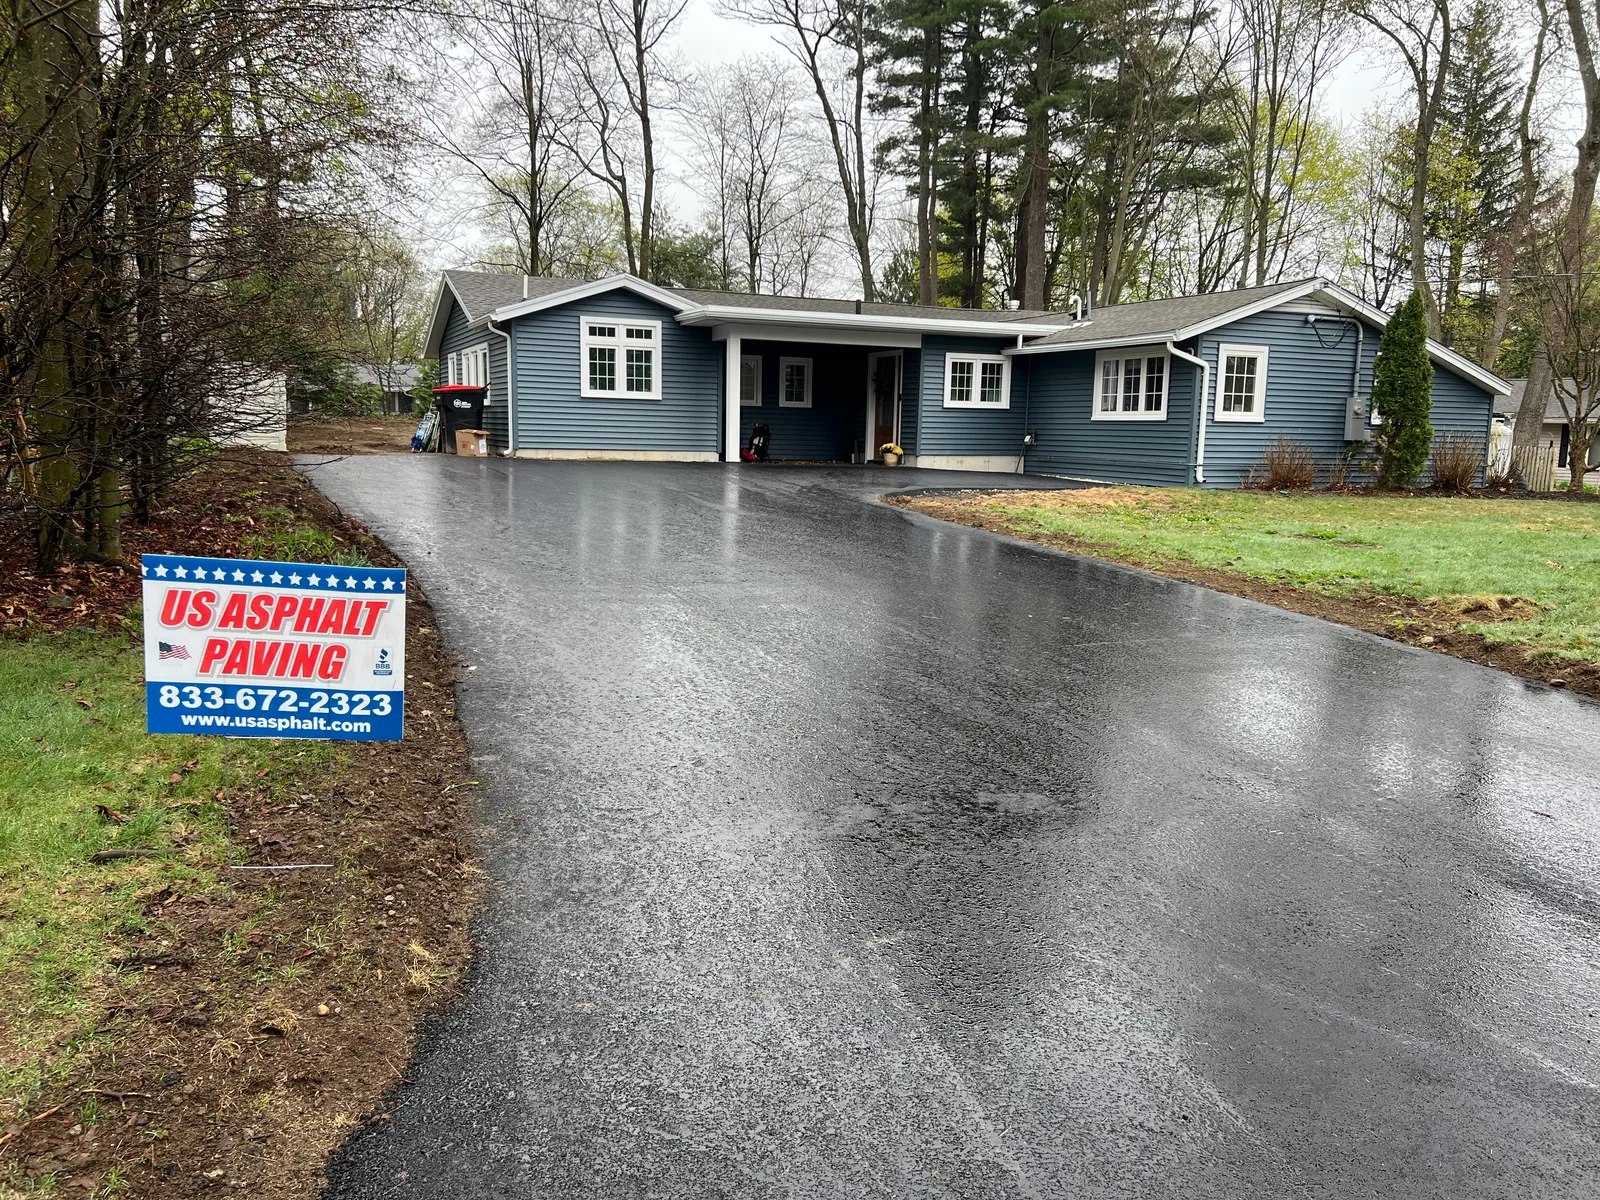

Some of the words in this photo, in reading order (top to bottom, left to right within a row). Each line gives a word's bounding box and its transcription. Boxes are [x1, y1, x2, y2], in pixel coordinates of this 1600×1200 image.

[159, 588, 217, 628] US
[217, 592, 390, 636] ASPHALT
[198, 638, 348, 681] PAVING
[159, 685, 392, 716] 833-672-2323
[181, 714, 371, 732] www.usasphalt.com
